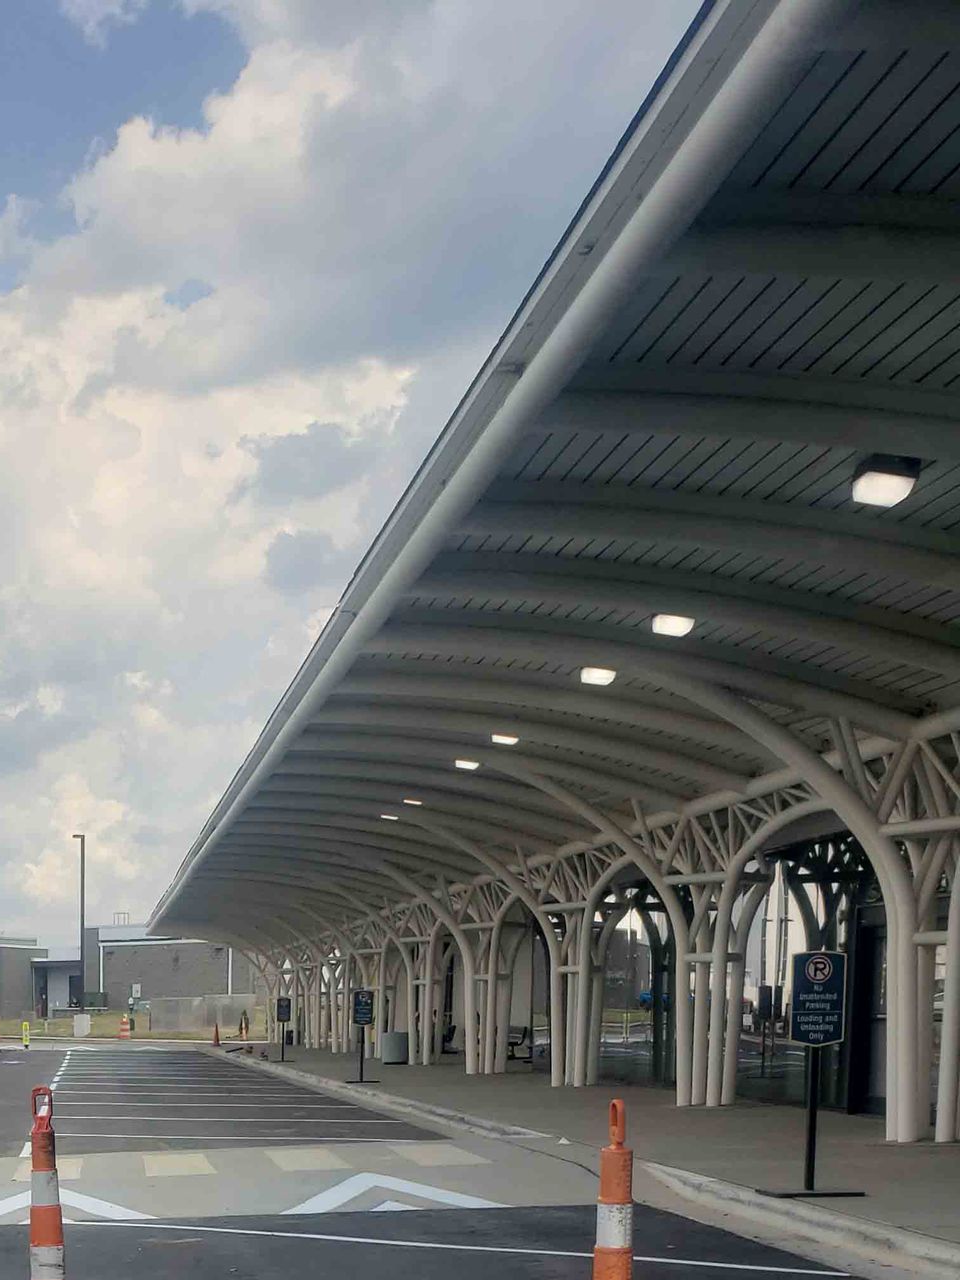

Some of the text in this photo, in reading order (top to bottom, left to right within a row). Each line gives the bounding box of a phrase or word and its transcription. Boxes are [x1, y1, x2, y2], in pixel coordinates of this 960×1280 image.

[805, 1002, 831, 1010] Parking
[797, 1015, 823, 1023] Loading
[800, 1023, 833, 1032] Unloading
[808, 1032, 825, 1040] Only
